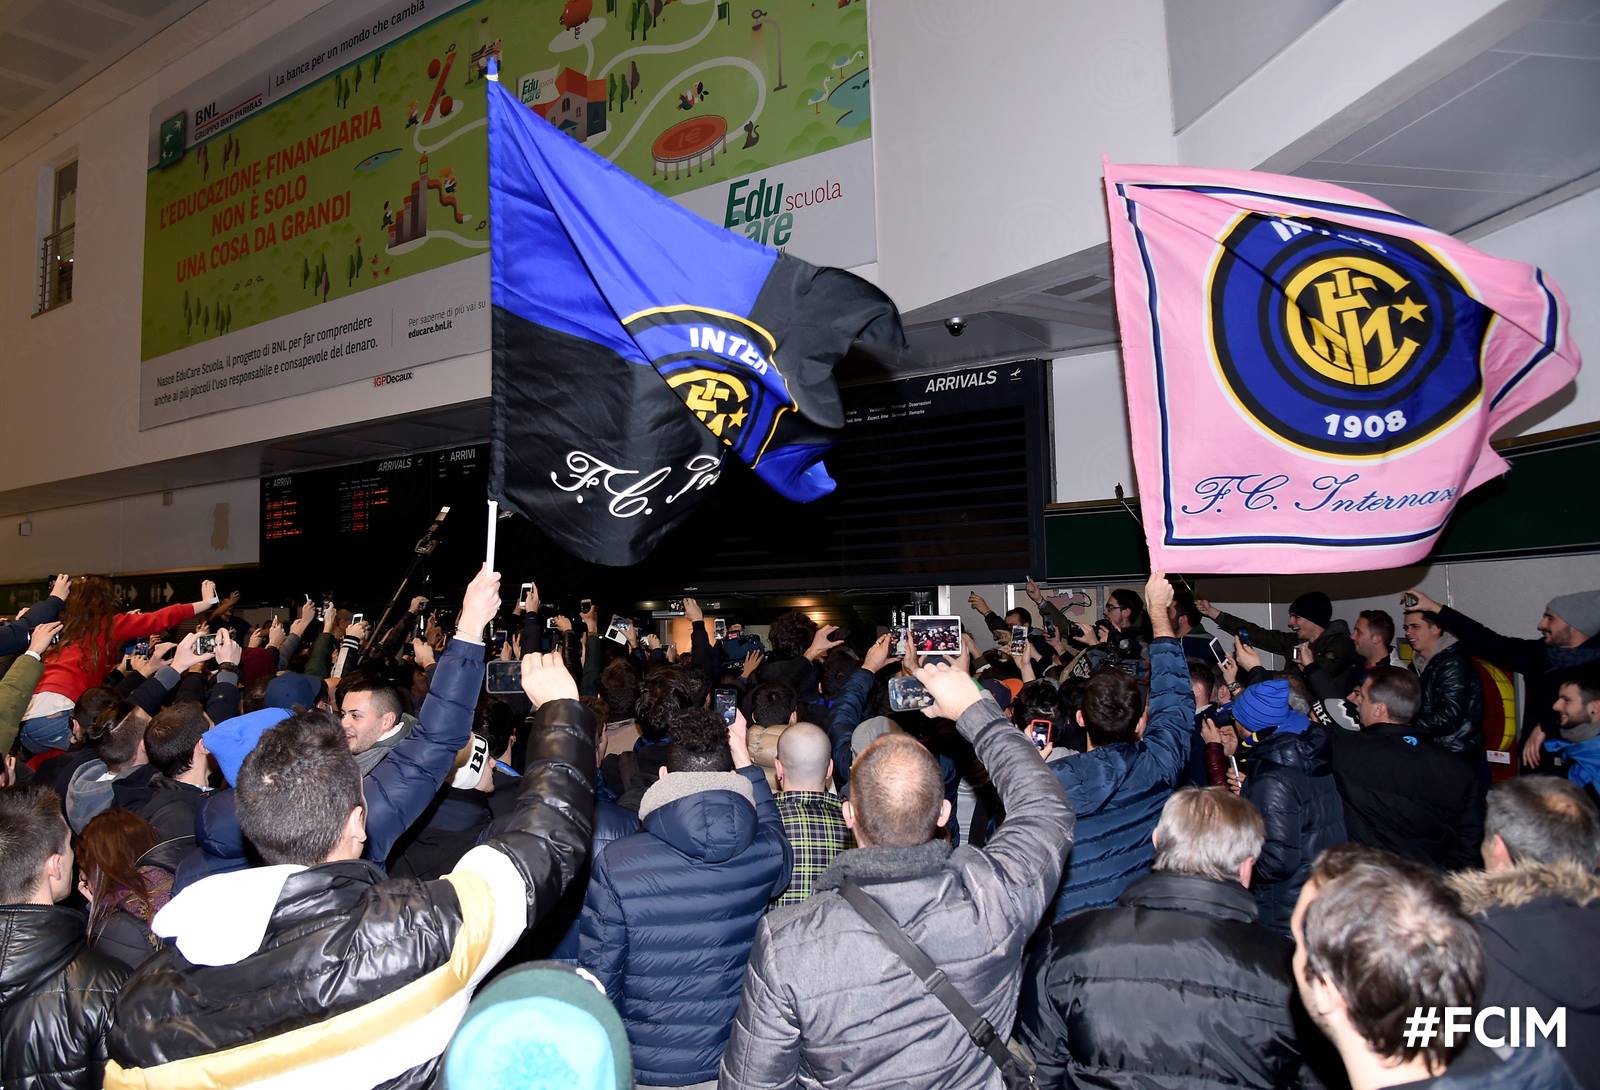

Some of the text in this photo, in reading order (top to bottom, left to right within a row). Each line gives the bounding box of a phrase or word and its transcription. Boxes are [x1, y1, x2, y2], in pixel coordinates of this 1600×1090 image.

[276, 0, 425, 87] La banca per un mondo che cambia
[194, 98, 263, 141] GRUPPO BNP PARIBAS
[195, 102, 220, 126] BNL
[160, 105, 383, 231] L'EDUCAZIONE FINANZIARIA
[211, 175, 308, 237] NON È SOLO
[724, 178, 785, 229] Edu
[785, 179, 843, 212] scuola
[176, 191, 351, 284] UNA COSA DA GRANDI
[408, 300, 487, 328] Per saperne di più vai su
[157, 376, 175, 387] Nasce
[176, 367, 201, 382] EduCare
[232, 349, 262, 369] progetto
[262, 343, 270, 357] di
[272, 340, 287, 354] BNL
[288, 337, 302, 353] per
[303, 332, 316, 349] far
[316, 316, 373, 342] comprendere
[154, 337, 379, 407] anche ai più piccoli l'uso responsabile e consapevole del denaro.
[925, 369, 998, 394] ARRIVALS
[1323, 409, 1408, 439] 1908
[377, 458, 413, 472] ARRIVALS
[449, 448, 477, 462] ARRIVI
[273, 476, 292, 488] ARRIVI
